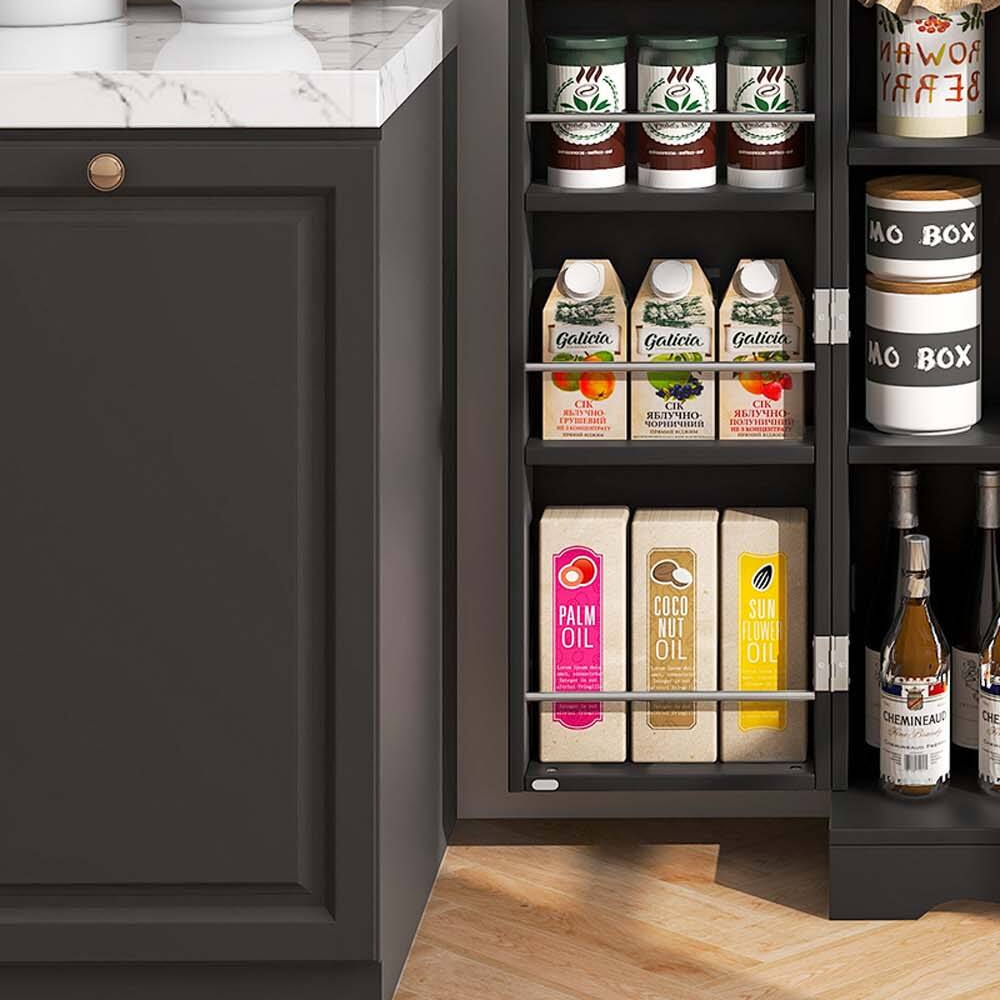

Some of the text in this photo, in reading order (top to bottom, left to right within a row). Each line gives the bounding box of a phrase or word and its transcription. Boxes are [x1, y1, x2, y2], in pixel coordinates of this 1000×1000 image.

[921, 221, 976, 247] BOX
[556, 331, 614, 350] Galicia
[644, 333, 705, 351] Galicia
[733, 331, 792, 348] Galicia
[916, 343, 972, 372] BOX
[574, 400, 593, 409] СІК
[665, 402, 684, 410] СІК
[752, 400, 772, 409] СІК
[644, 420, 704, 428] ЧОРНИЧНИЙ
[559, 604, 596, 626] PALM
[654, 595, 688, 616] COCO
[749, 599, 776, 620] SUN
[561, 627, 594, 649] OIL
[658, 617, 684, 638] NUT
[742, 620, 783, 641] FLOWER
[655, 639, 688, 660] OIL
[747, 641, 778, 664] OIL
[882, 710, 947, 727] CHEMINEAUD
